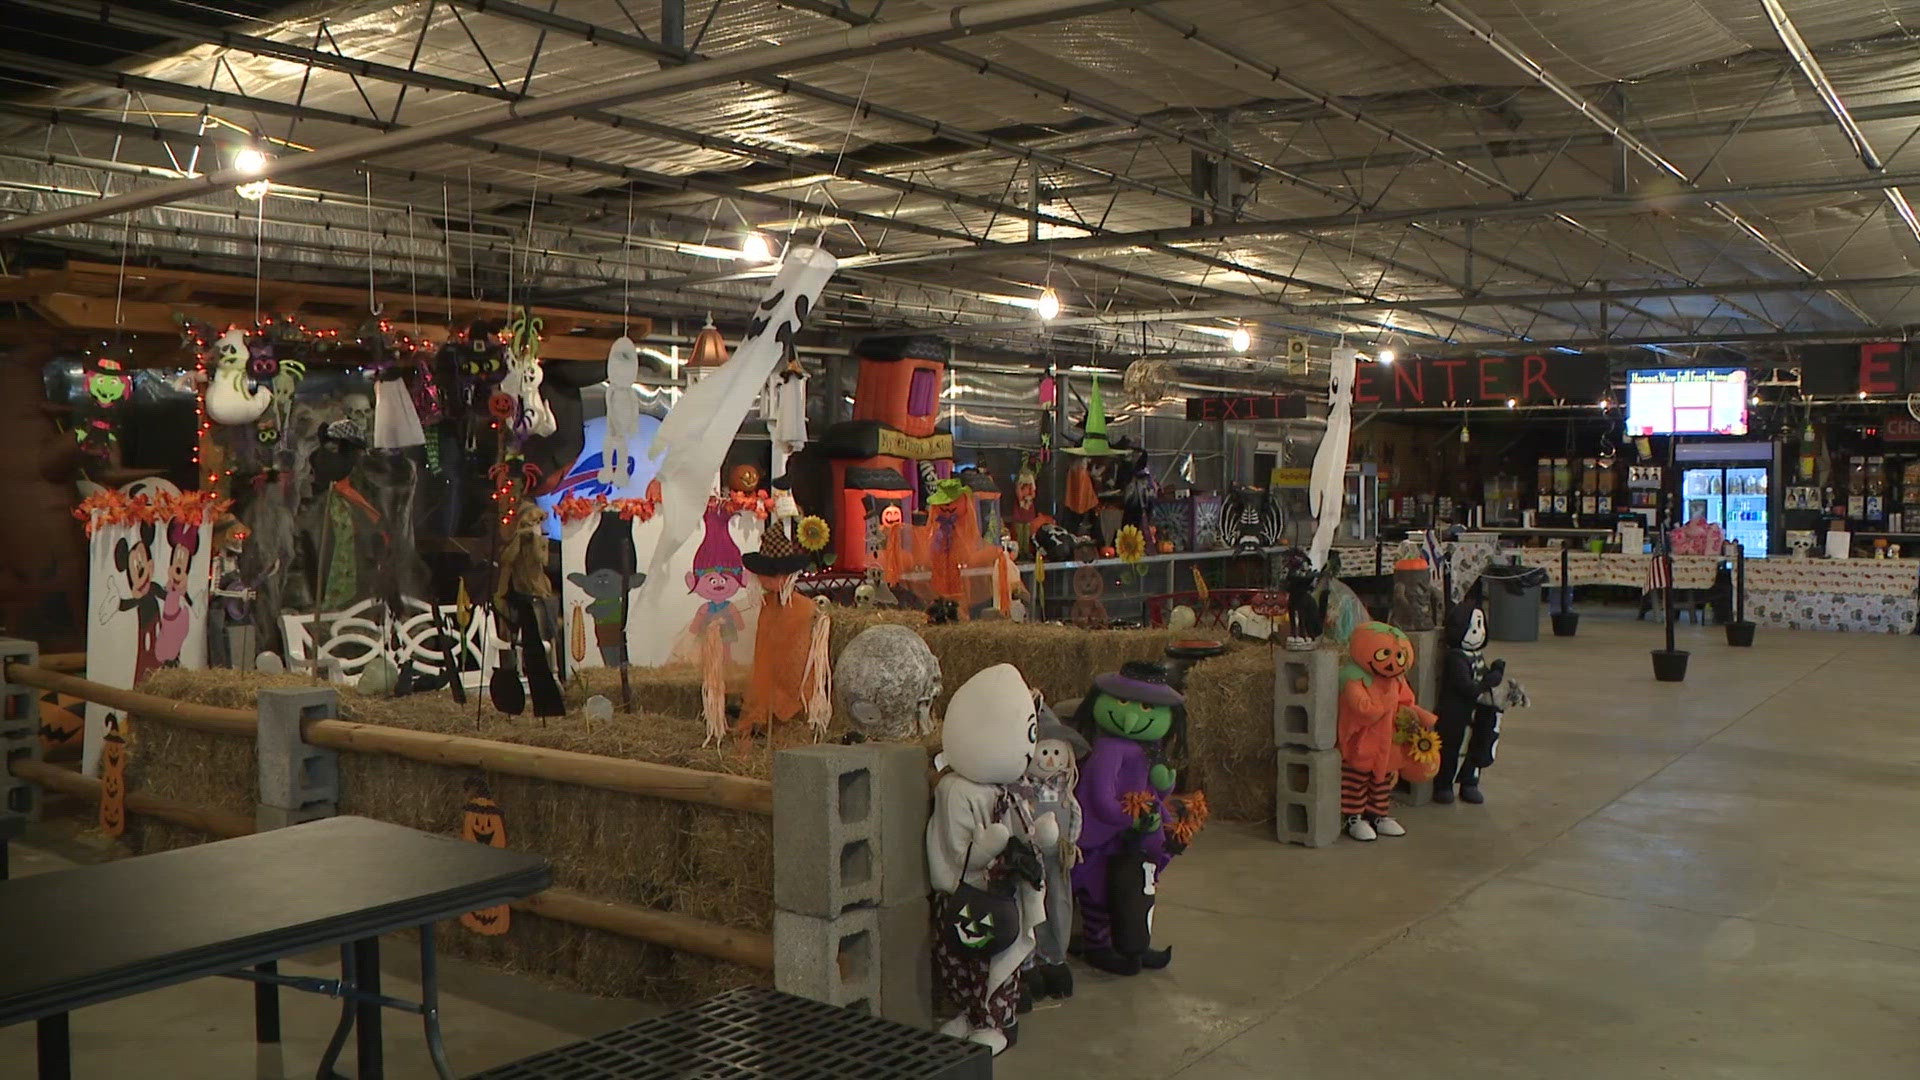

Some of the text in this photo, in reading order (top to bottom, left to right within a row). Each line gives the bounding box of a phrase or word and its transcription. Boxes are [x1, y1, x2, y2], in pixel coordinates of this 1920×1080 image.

[1354, 355, 1559, 403] ENTER
[1631, 372, 1659, 383] Harvest
[1659, 371, 1676, 382] View
[1677, 370, 1690, 382] Fall
[1691, 370, 1706, 382] Fest
[1203, 397, 1286, 419] EXIT
